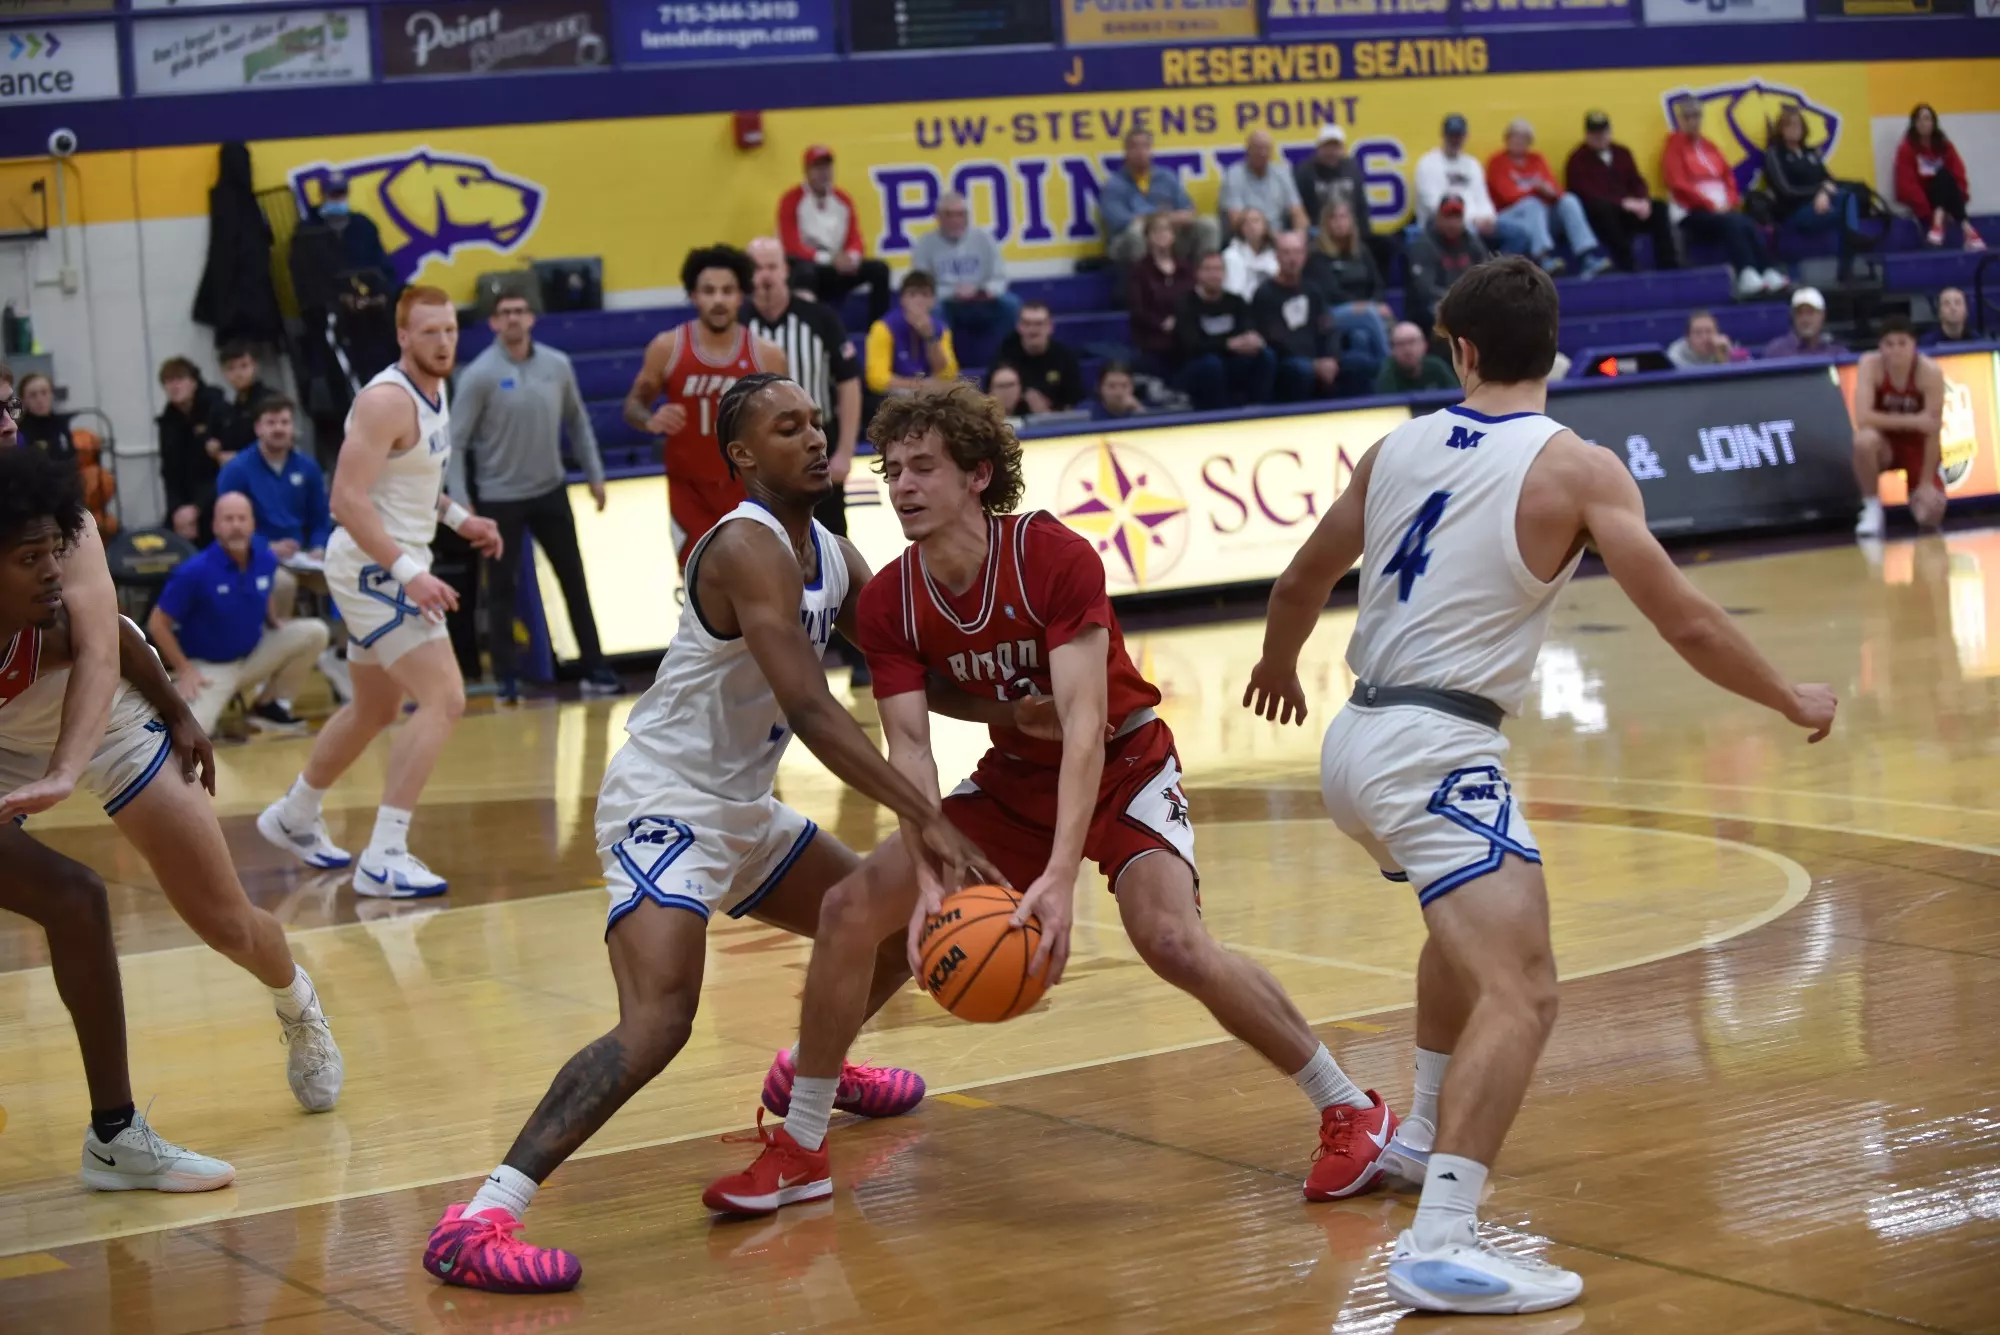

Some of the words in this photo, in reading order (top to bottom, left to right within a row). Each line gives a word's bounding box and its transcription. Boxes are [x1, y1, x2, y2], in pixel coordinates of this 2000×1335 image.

[405, 8, 501, 66] Point
[1161, 44, 1341, 85] RESERVED
[1353, 36, 1489, 77] SEATING
[0, 70, 74, 97] ance
[915, 105, 1218, 149] UW-STEVENS
[1236, 97, 1360, 131] POINT
[872, 142, 1405, 252] POINTS
[1445, 425, 1488, 450] M
[1625, 434, 1667, 480] &
[1688, 419, 1796, 474] JOINT
[1380, 490, 1453, 603] 4
[927, 944, 969, 992] NCAA
